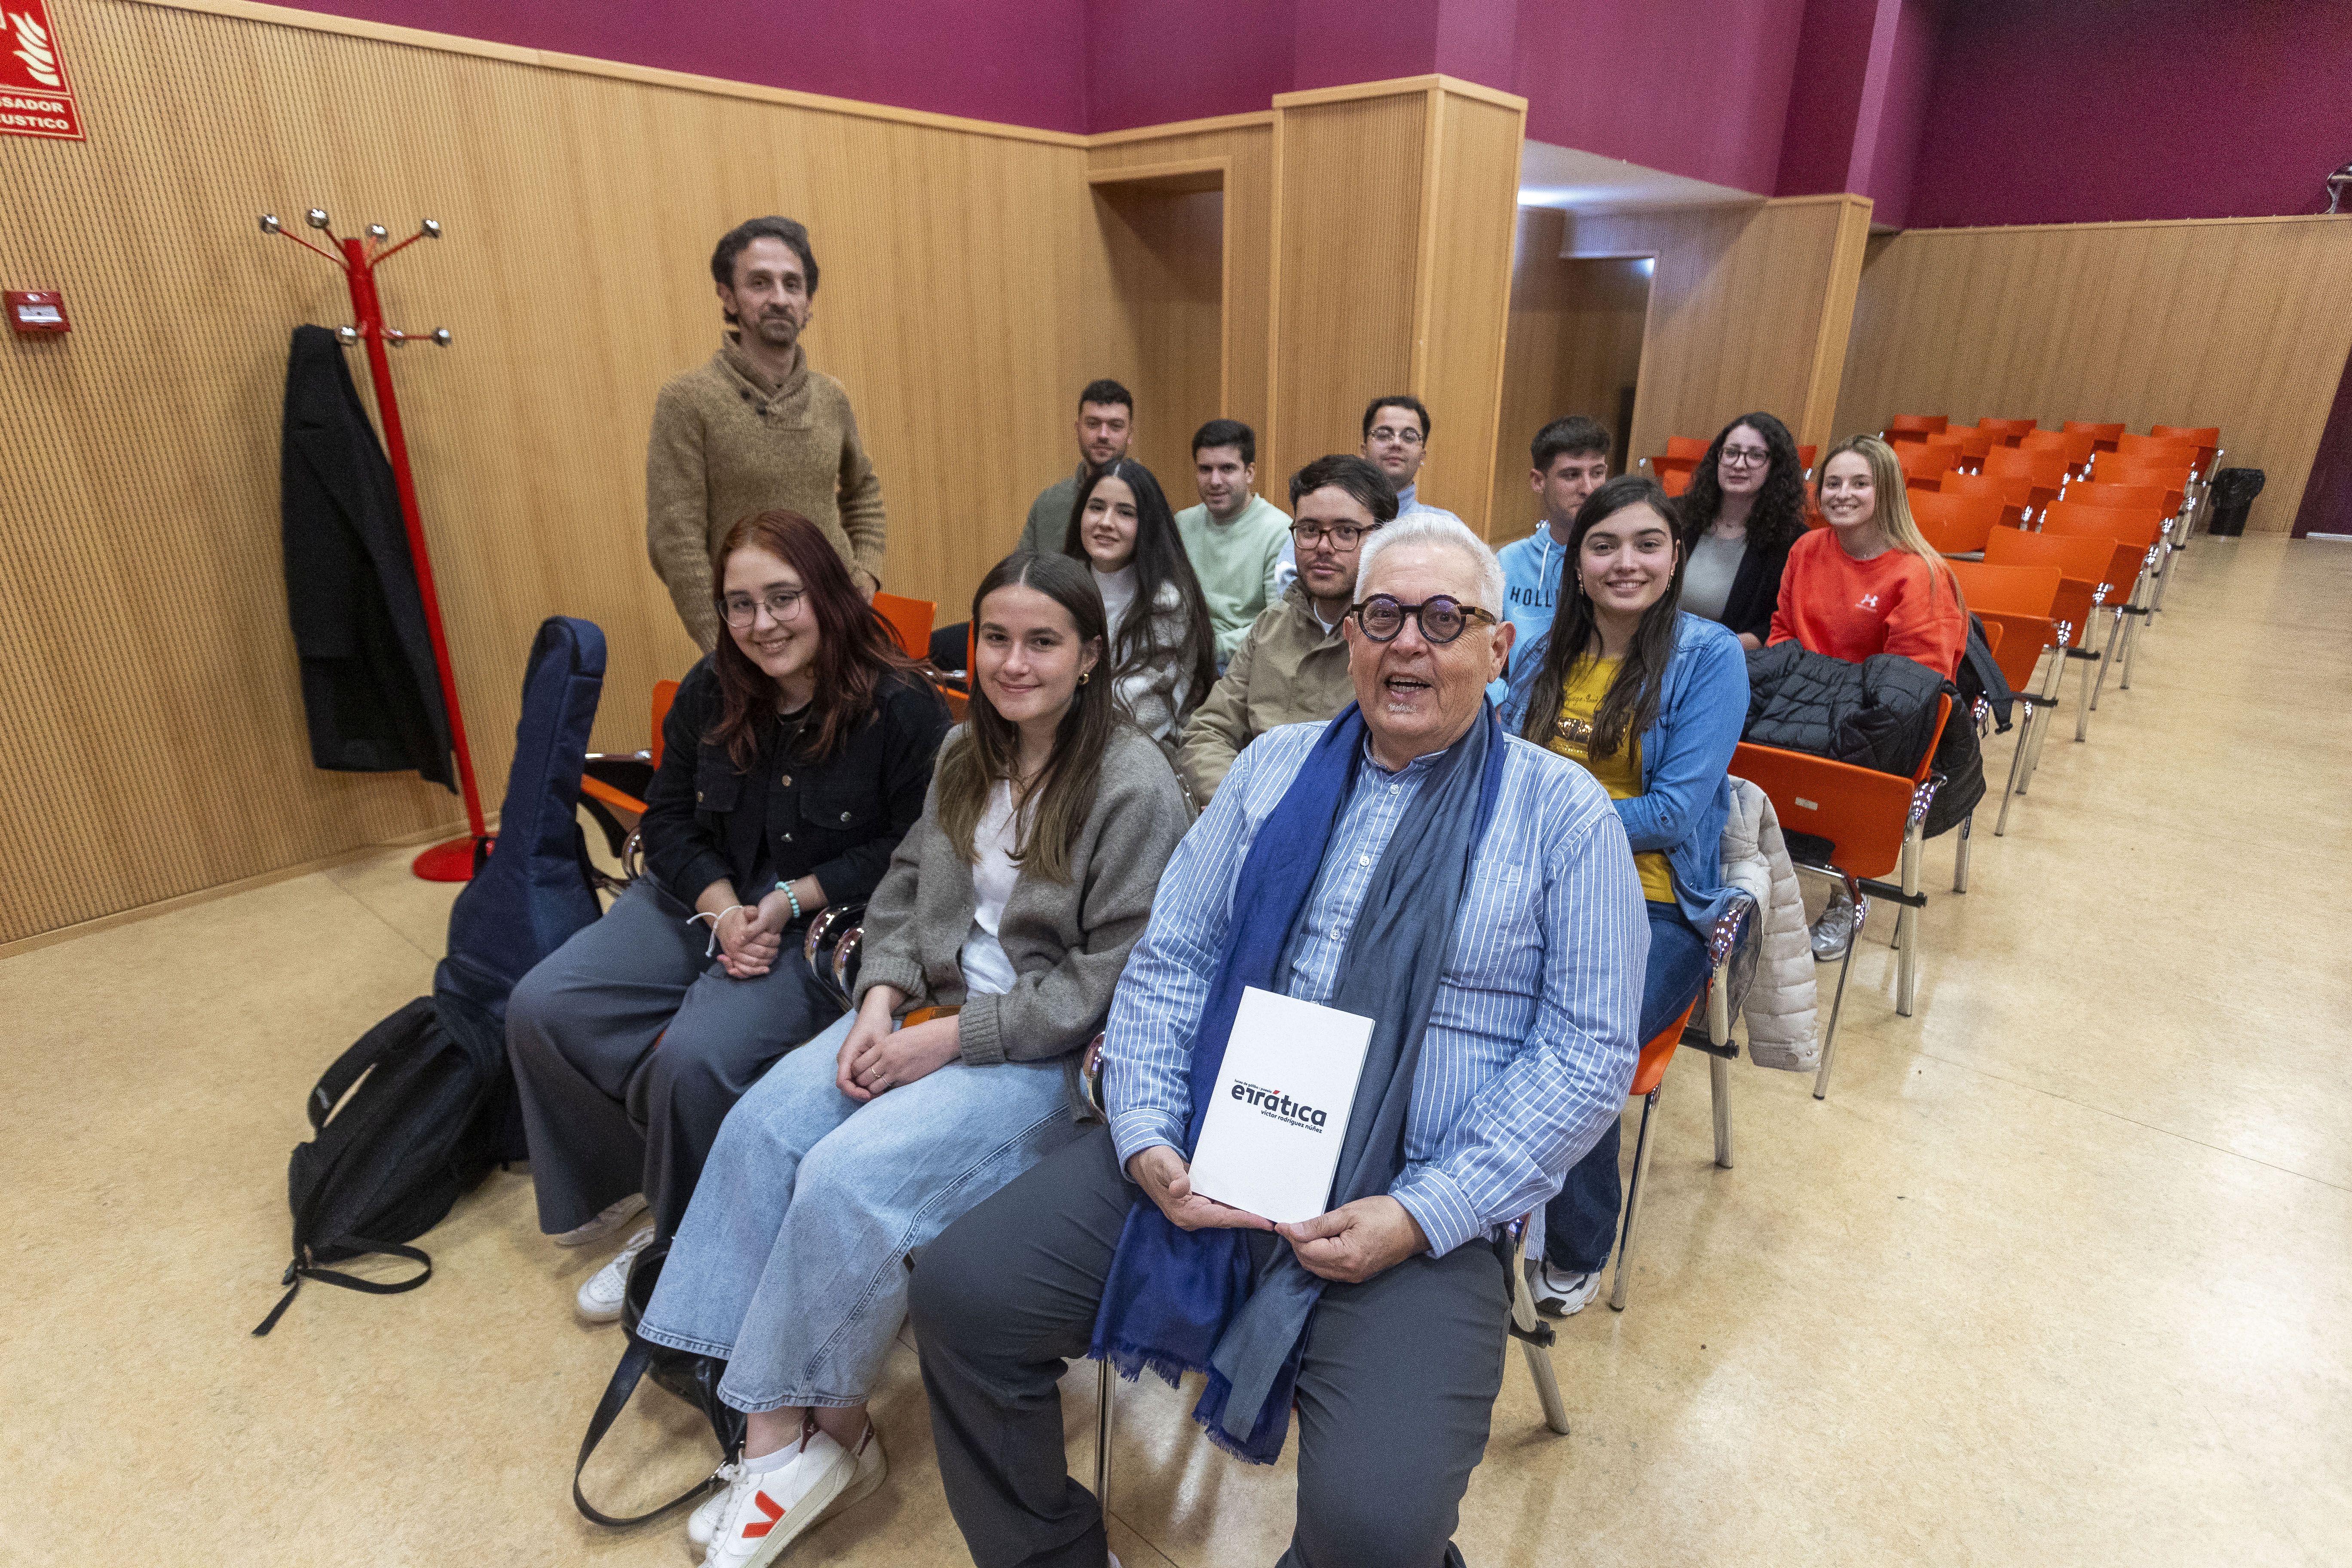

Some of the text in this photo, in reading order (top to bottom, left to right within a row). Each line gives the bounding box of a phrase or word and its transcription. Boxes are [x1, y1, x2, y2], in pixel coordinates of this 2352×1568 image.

[0, 97, 65, 113] SADOR
[0, 114, 69, 129] USTICO
[1510, 586, 1552, 607] HOLL
[1261, 1110, 1323, 1134] víctor rodríguez núñez
